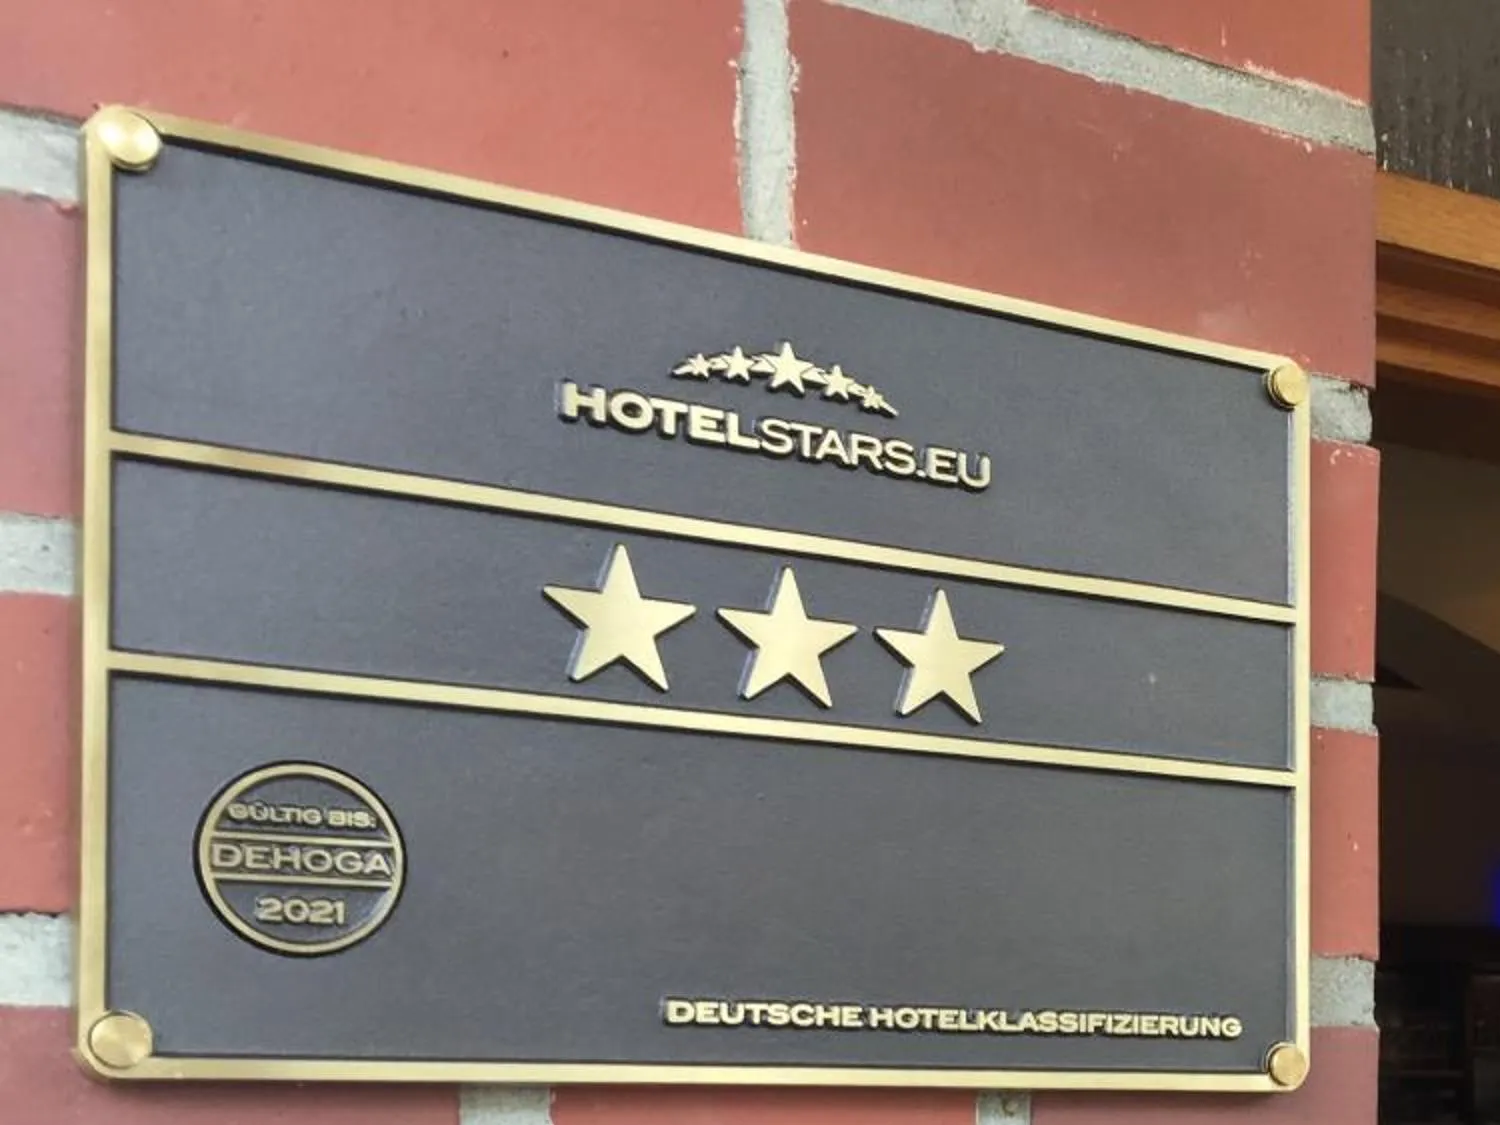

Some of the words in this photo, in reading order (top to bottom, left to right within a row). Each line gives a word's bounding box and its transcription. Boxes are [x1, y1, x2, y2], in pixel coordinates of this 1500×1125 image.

[562, 381, 992, 488] HOTELSTARS.EU
[211, 844, 391, 875] DEHOGA
[255, 898, 346, 924] 2021
[666, 1000, 863, 1028] DEUTSCHE
[868, 1007, 1243, 1038] HOTELKLASSIFIZIERUNG
